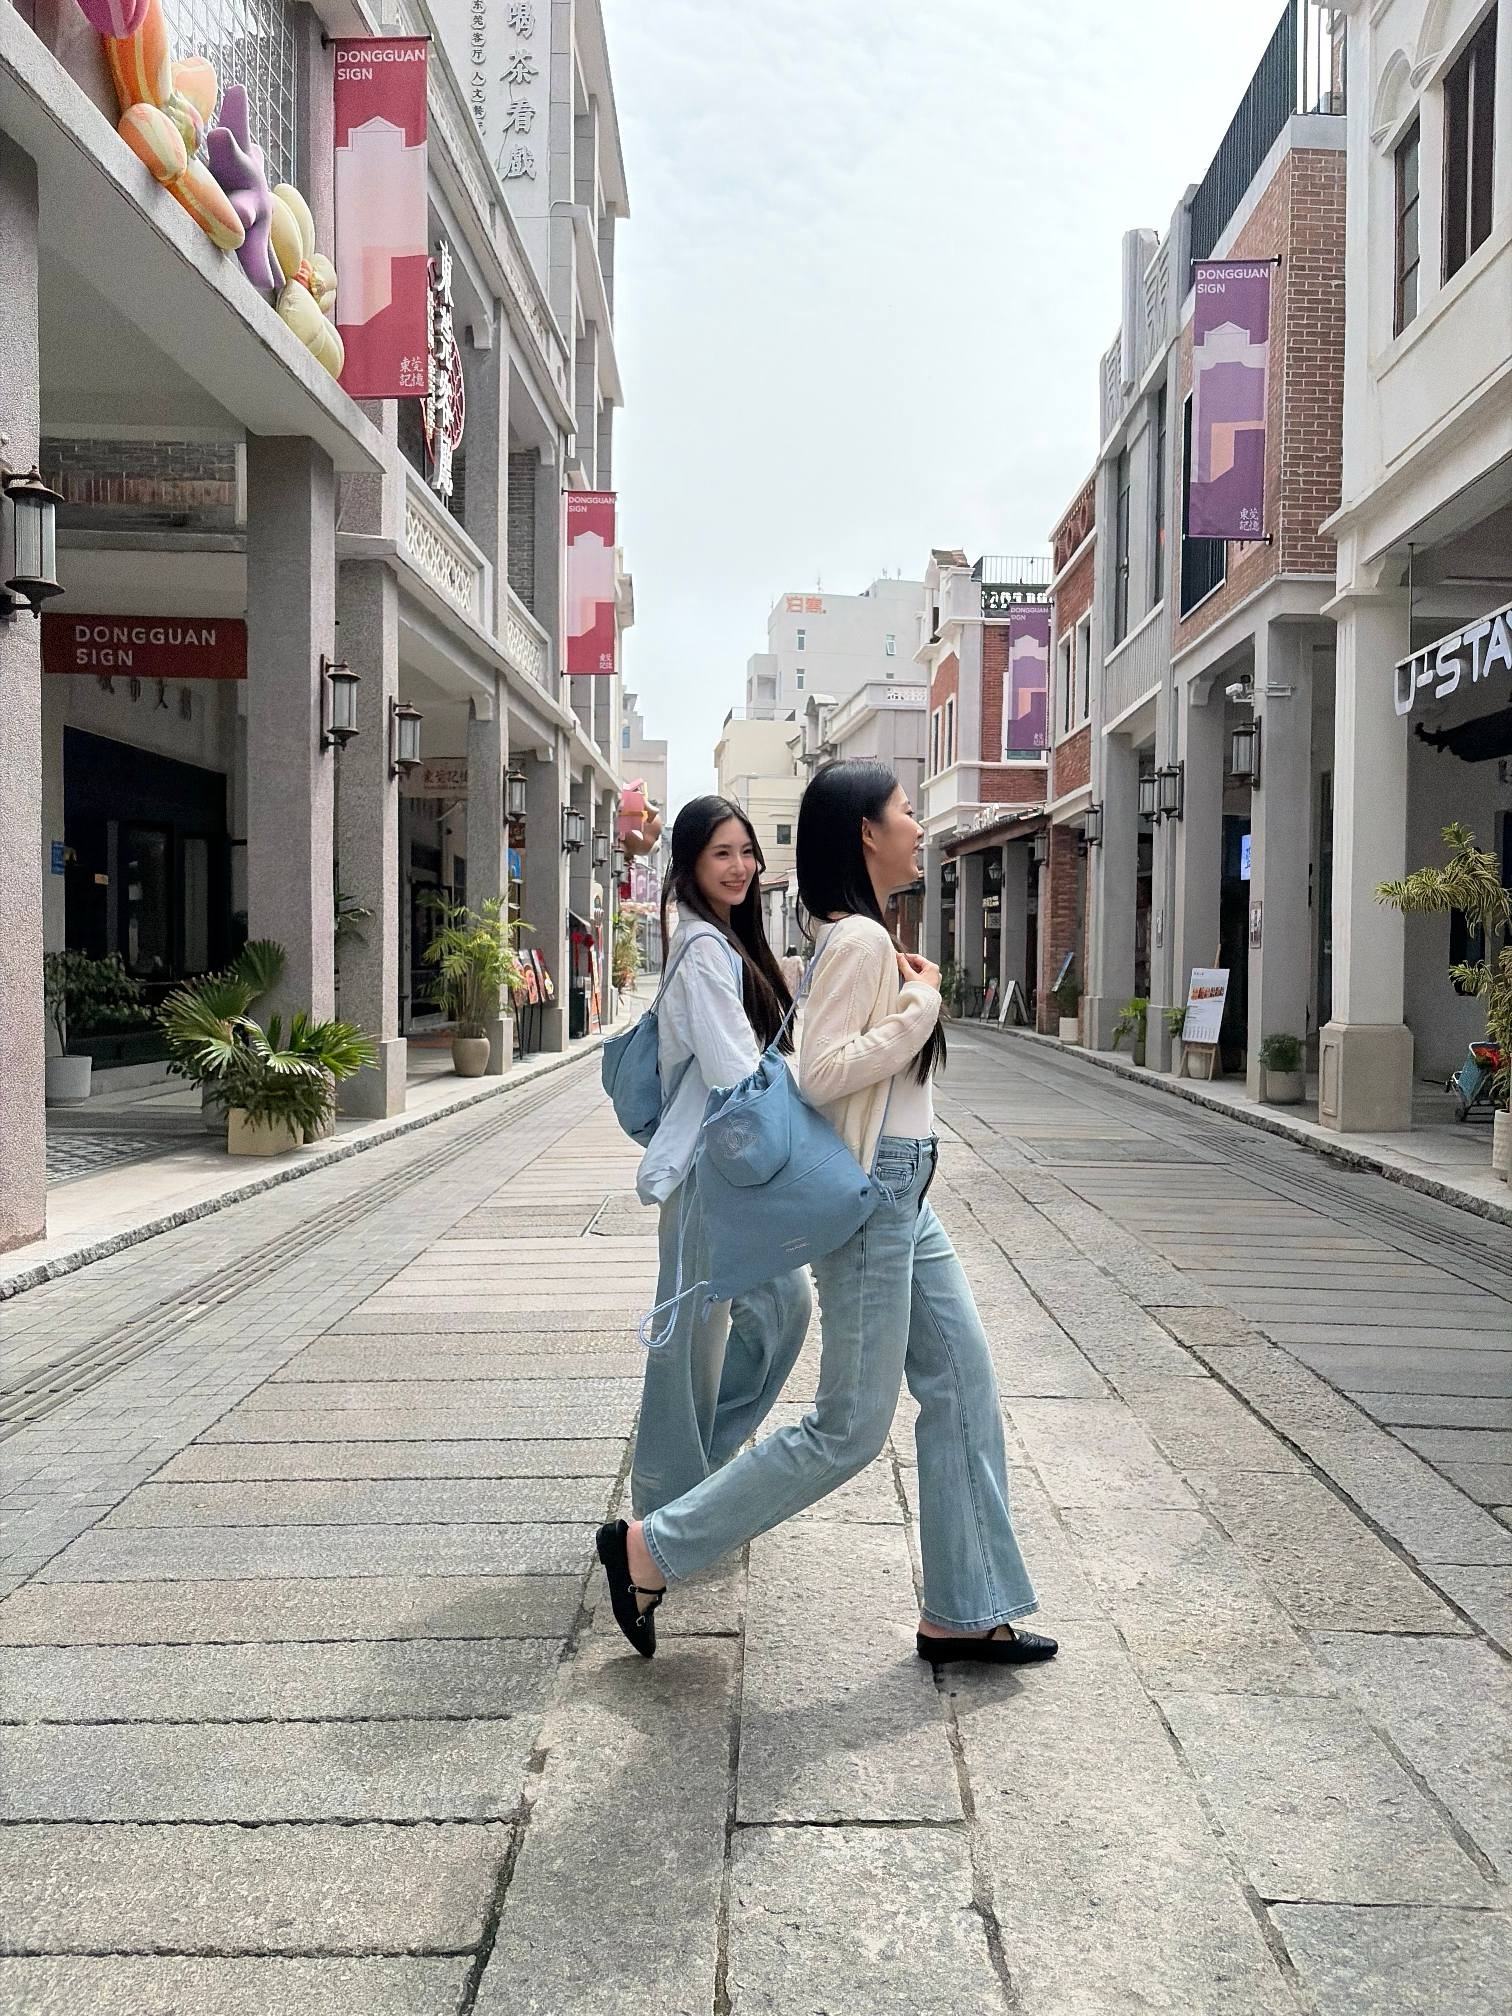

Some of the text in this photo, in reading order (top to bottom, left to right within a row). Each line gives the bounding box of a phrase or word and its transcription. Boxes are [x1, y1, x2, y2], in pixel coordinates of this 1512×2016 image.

[337, 49, 425, 63] DONGGUAN
[337, 68, 373, 80] SIGN
[1197, 268, 1269, 280] DONGGUAN
[1197, 283, 1226, 294] SIGN
[568, 496, 615, 504] DONGGUAN
[568, 505, 588, 513] SIGN
[75, 625, 216, 645] DONGGUAN
[76, 649, 133, 666] SIGN
[1394, 610, 1512, 716] U-STA
